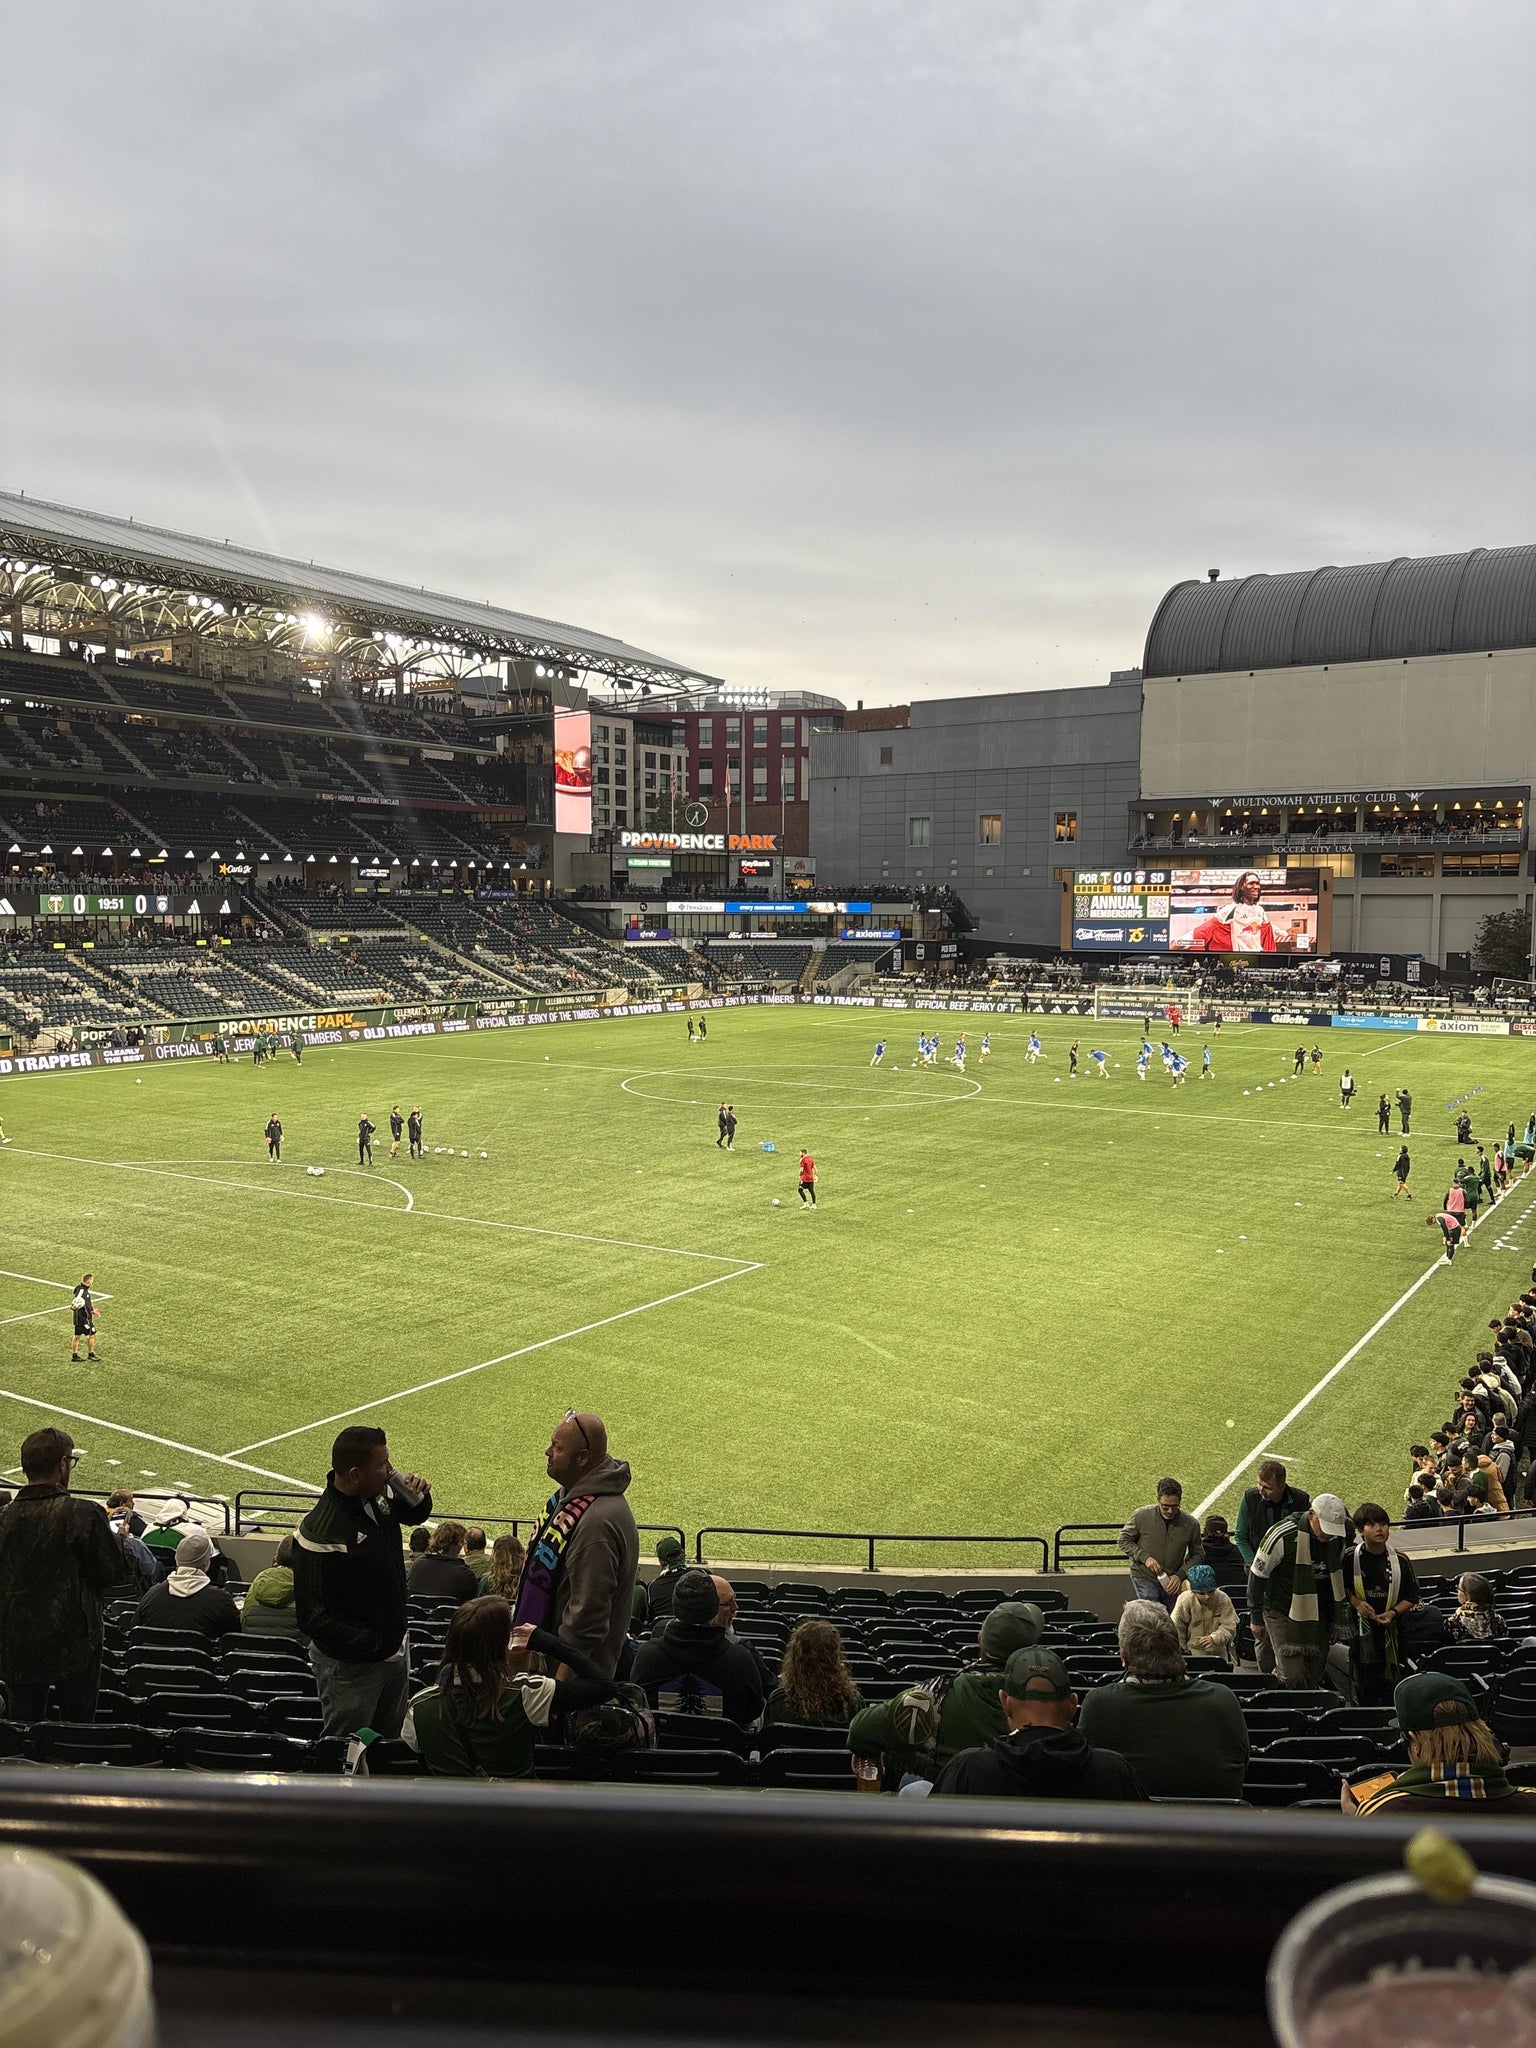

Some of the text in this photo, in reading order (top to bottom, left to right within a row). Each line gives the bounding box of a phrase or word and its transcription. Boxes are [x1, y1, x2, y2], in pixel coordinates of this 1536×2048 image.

[1232, 792, 1397, 807] MULTNOMAH ATHLETIC CLUB
[621, 832, 778, 850] PROVIDENCE PARK
[1272, 846, 1306, 854] SOCCER
[1335, 845, 1354, 853] USA
[1079, 874, 1097, 884] POR
[1114, 872, 1120, 884] 0
[1124, 872, 1132, 884] 0
[1150, 872, 1164, 883] SD
[73, 894, 147, 914] 0 19:51 0
[1076, 896, 1143, 910] 20 ANNUAL
[1076, 907, 1143, 918] 26 MEMBERSHIPS
[640, 930, 657, 938] xfinity
[545, 996, 575, 1005] CELEBRATING
[690, 1001, 712, 1009] OFFICIAL
[712, 999, 723, 1007] BEEF
[725, 998, 740, 1006] JERKY
[760, 994, 795, 1004] TIMBERS
[814, 995, 875, 1007] OLD TRAPPER
[915, 1000, 948, 1010] OFFICIAL
[950, 1001, 969, 1010] BEEF
[970, 1002, 996, 1012] JERKY
[997, 1003, 1008, 1012] OF
[431, 1006, 440, 1014] 50
[613, 1004, 662, 1016] OLD TRAPPER
[220, 1013, 355, 1035] PROVIDENCE PARK
[476, 1009, 599, 1029] OFFICIAL BEEF JERKY OF THE TIMBERS
[1271, 1014, 1309, 1025] Gillette
[364, 1023, 436, 1039] OLD TRAPPER
[1440, 1021, 1479, 1032] axiom
[156, 1043, 203, 1059] OFFICIAL
[302, 1030, 342, 1045] TIMBERS
[103, 1048, 140, 1057] CLEARLY
[123, 1054, 145, 1062] BEST
[15, 1052, 92, 1072] TRAPPER
